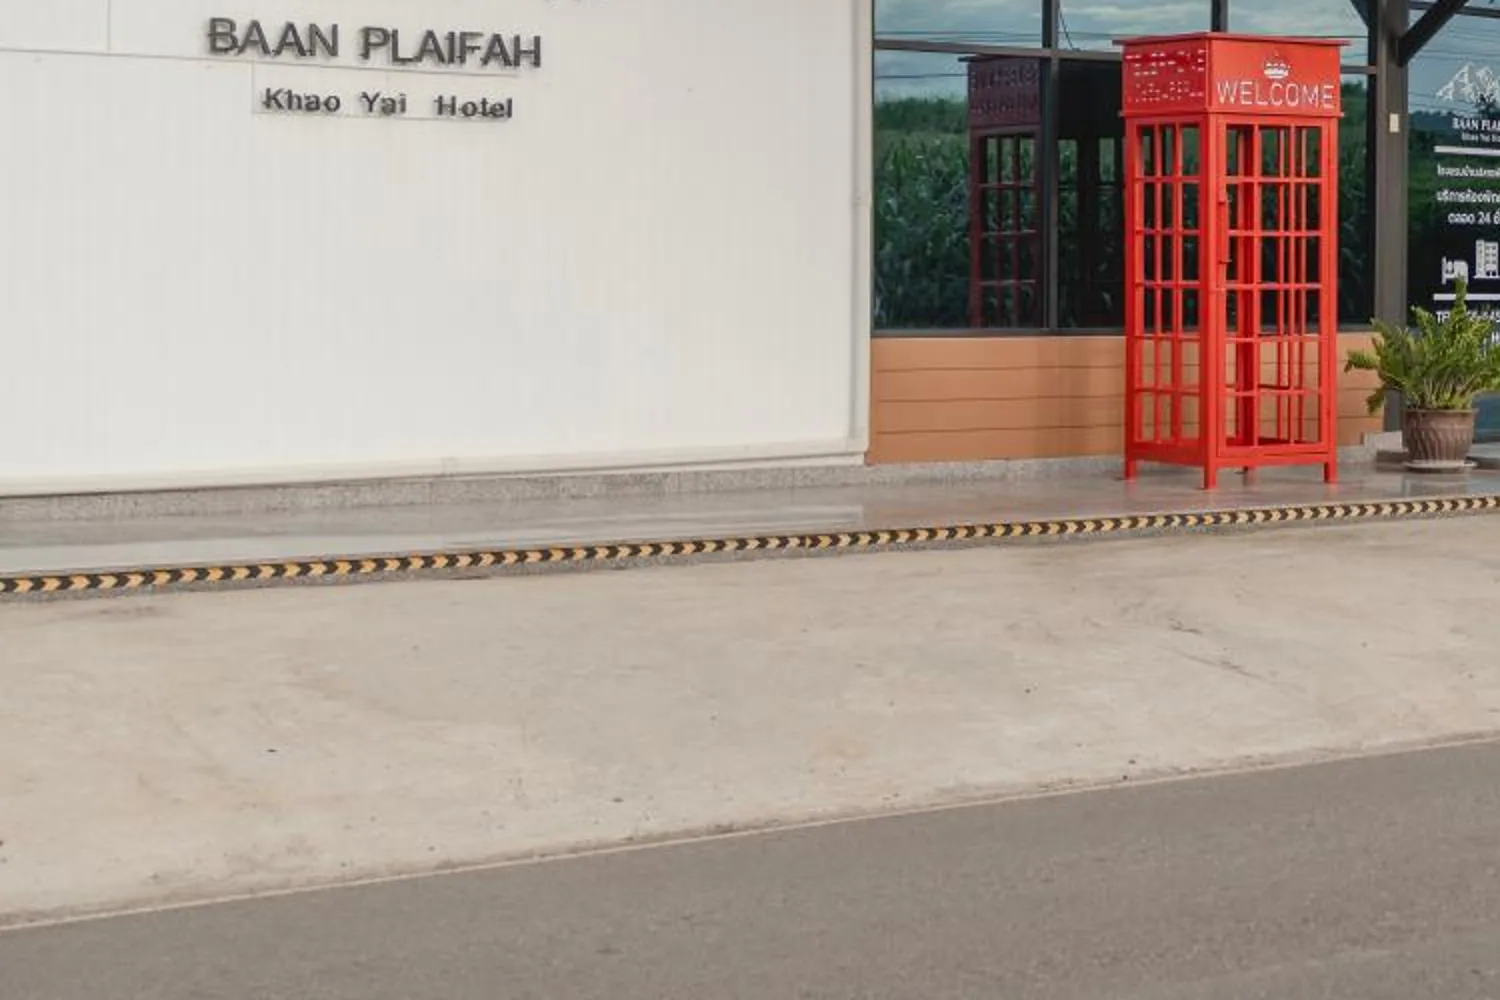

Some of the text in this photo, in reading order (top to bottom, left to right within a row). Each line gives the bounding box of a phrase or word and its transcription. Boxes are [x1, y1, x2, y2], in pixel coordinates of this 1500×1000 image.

[208, 17, 542, 69] BAAN PLAIFAH
[264, 87, 513, 119] Khao Yai Hotel
[1216, 80, 1335, 109] WELCOME
[1451, 117, 1479, 130] BAAN
[1477, 211, 1491, 225] 24
